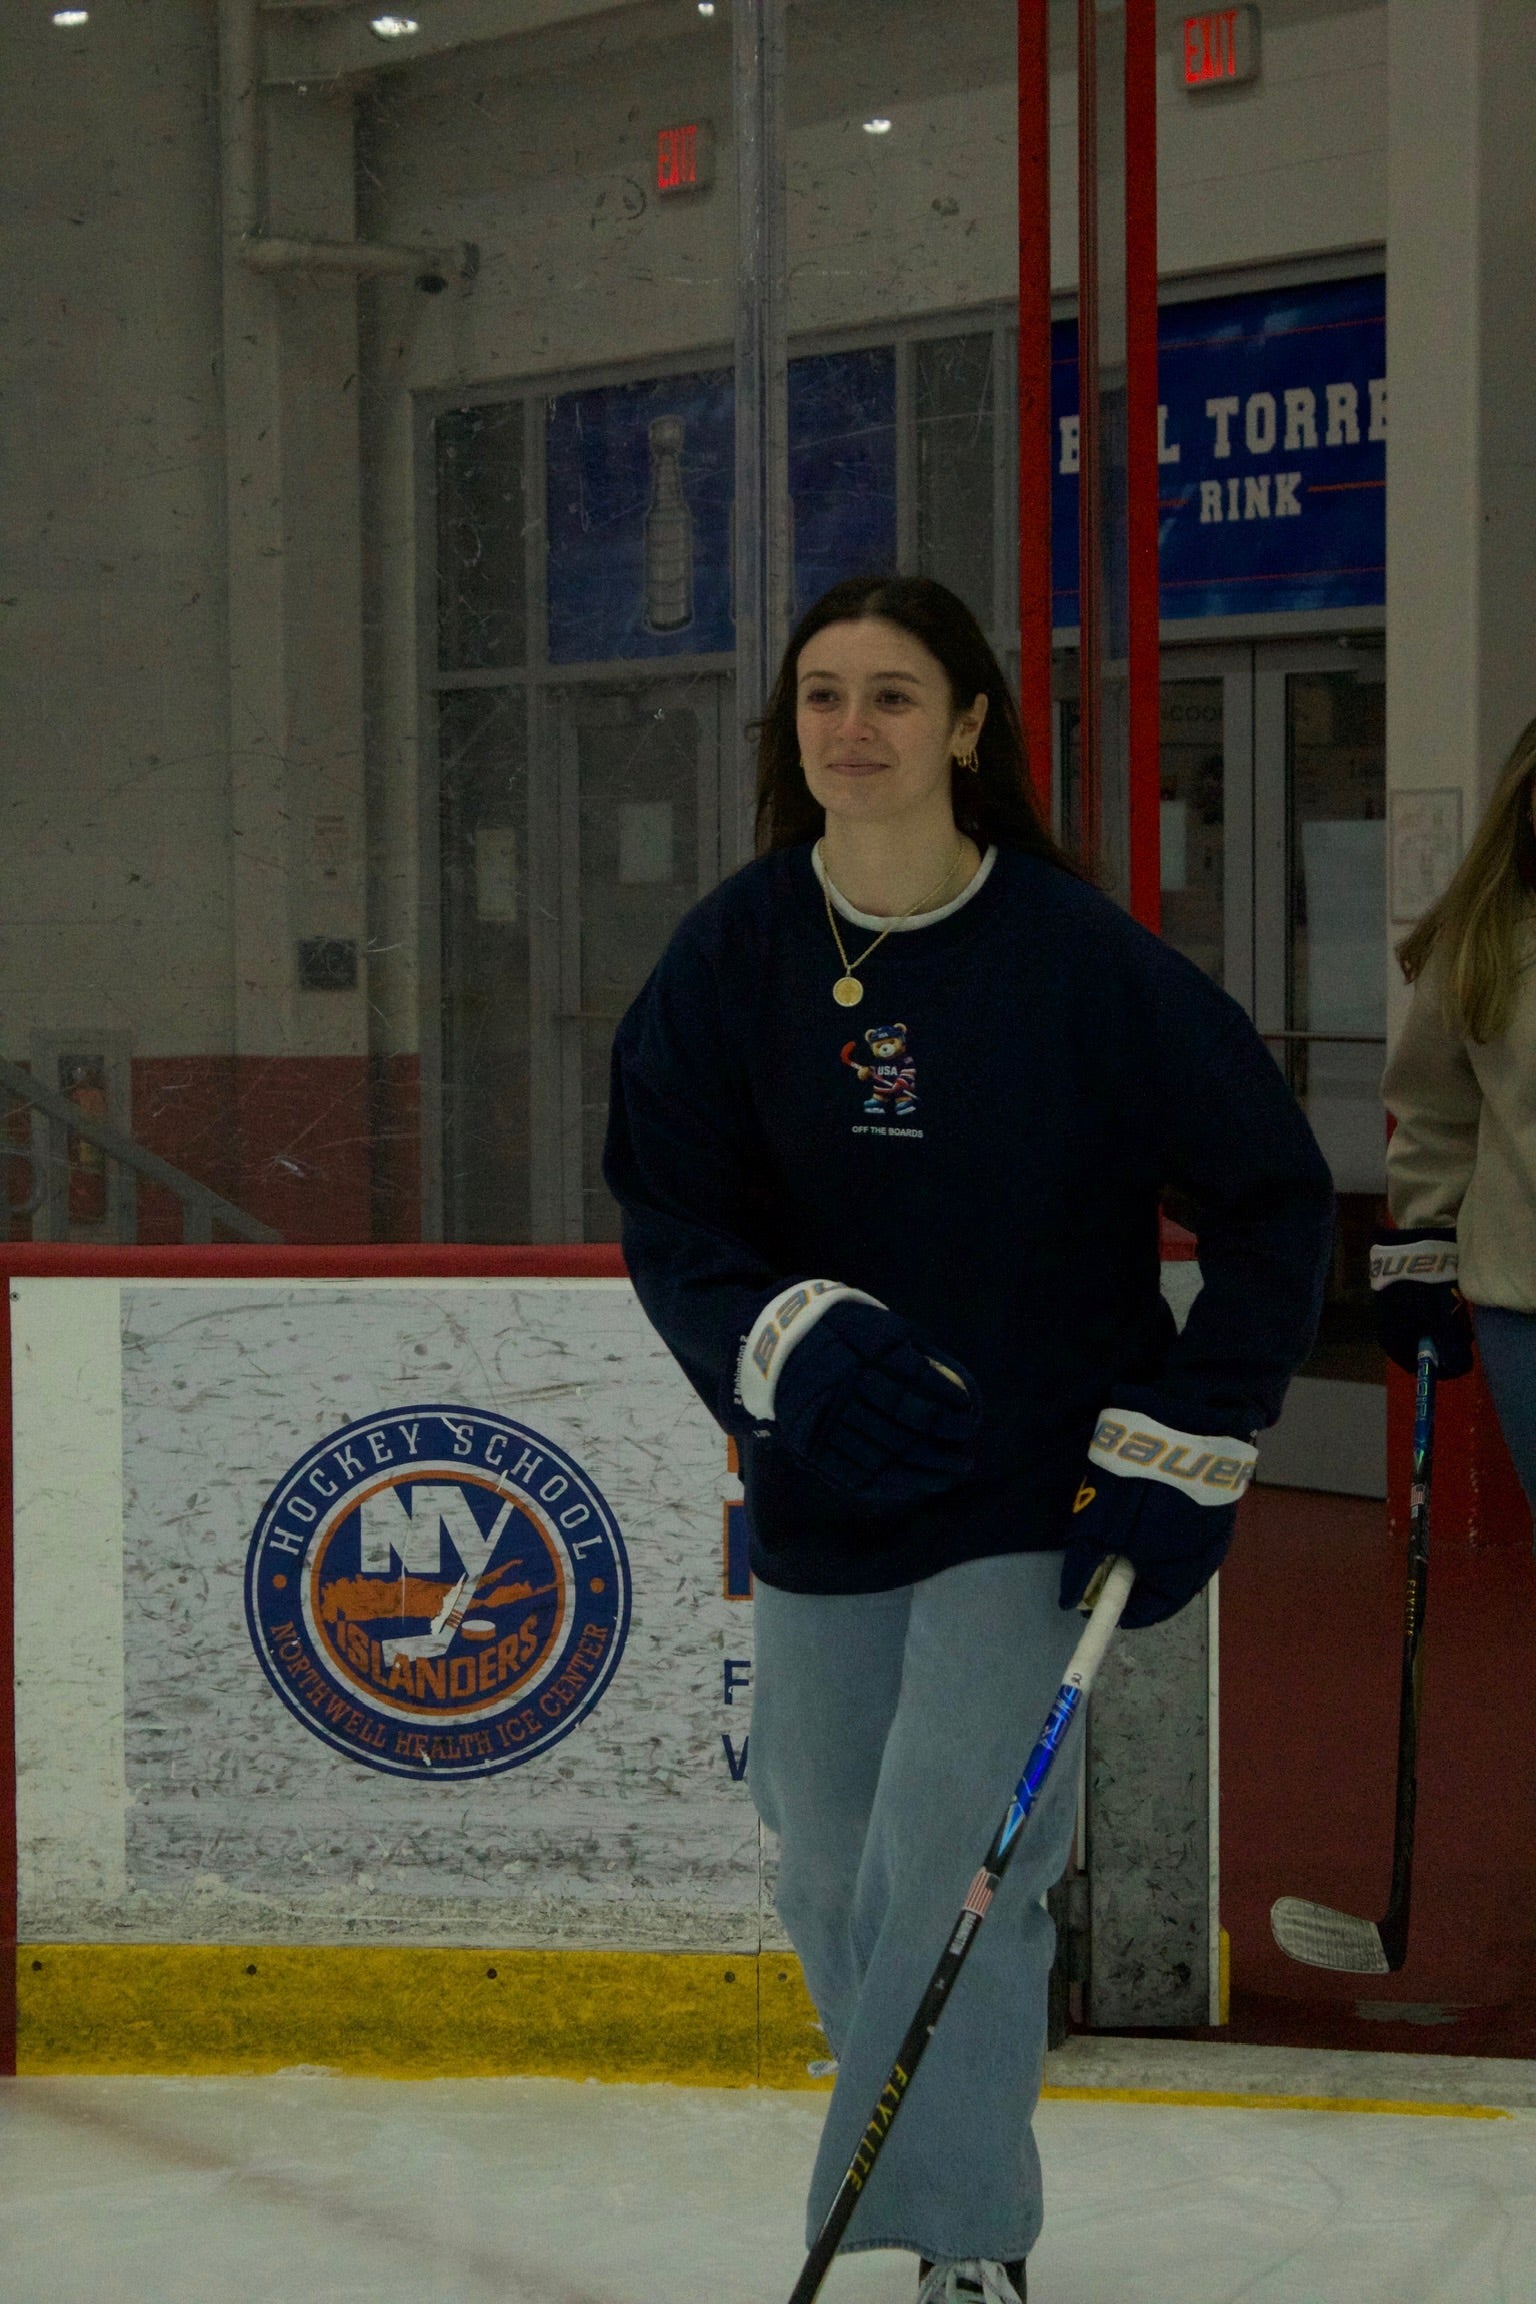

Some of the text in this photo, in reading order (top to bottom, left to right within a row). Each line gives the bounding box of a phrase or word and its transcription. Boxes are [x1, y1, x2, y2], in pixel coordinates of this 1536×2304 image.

[1184, 9, 1238, 83] EXIT
[657, 124, 698, 188] EXIT
[1199, 471, 1302, 524] RINK
[877, 1065, 898, 1076] USA
[851, 1125, 924, 1139] OFF THE BOARDS
[269, 1423, 420, 1556] HOCKEY
[453, 1424, 603, 1561] SCHOOL
[360, 1485, 515, 1574] NY
[270, 1621, 608, 1760] NORTHWELL HEALTH ICE CENTER
[336, 1613, 539, 1701] ISLANDERS
[848, 2062, 911, 2193] FLYLITE
